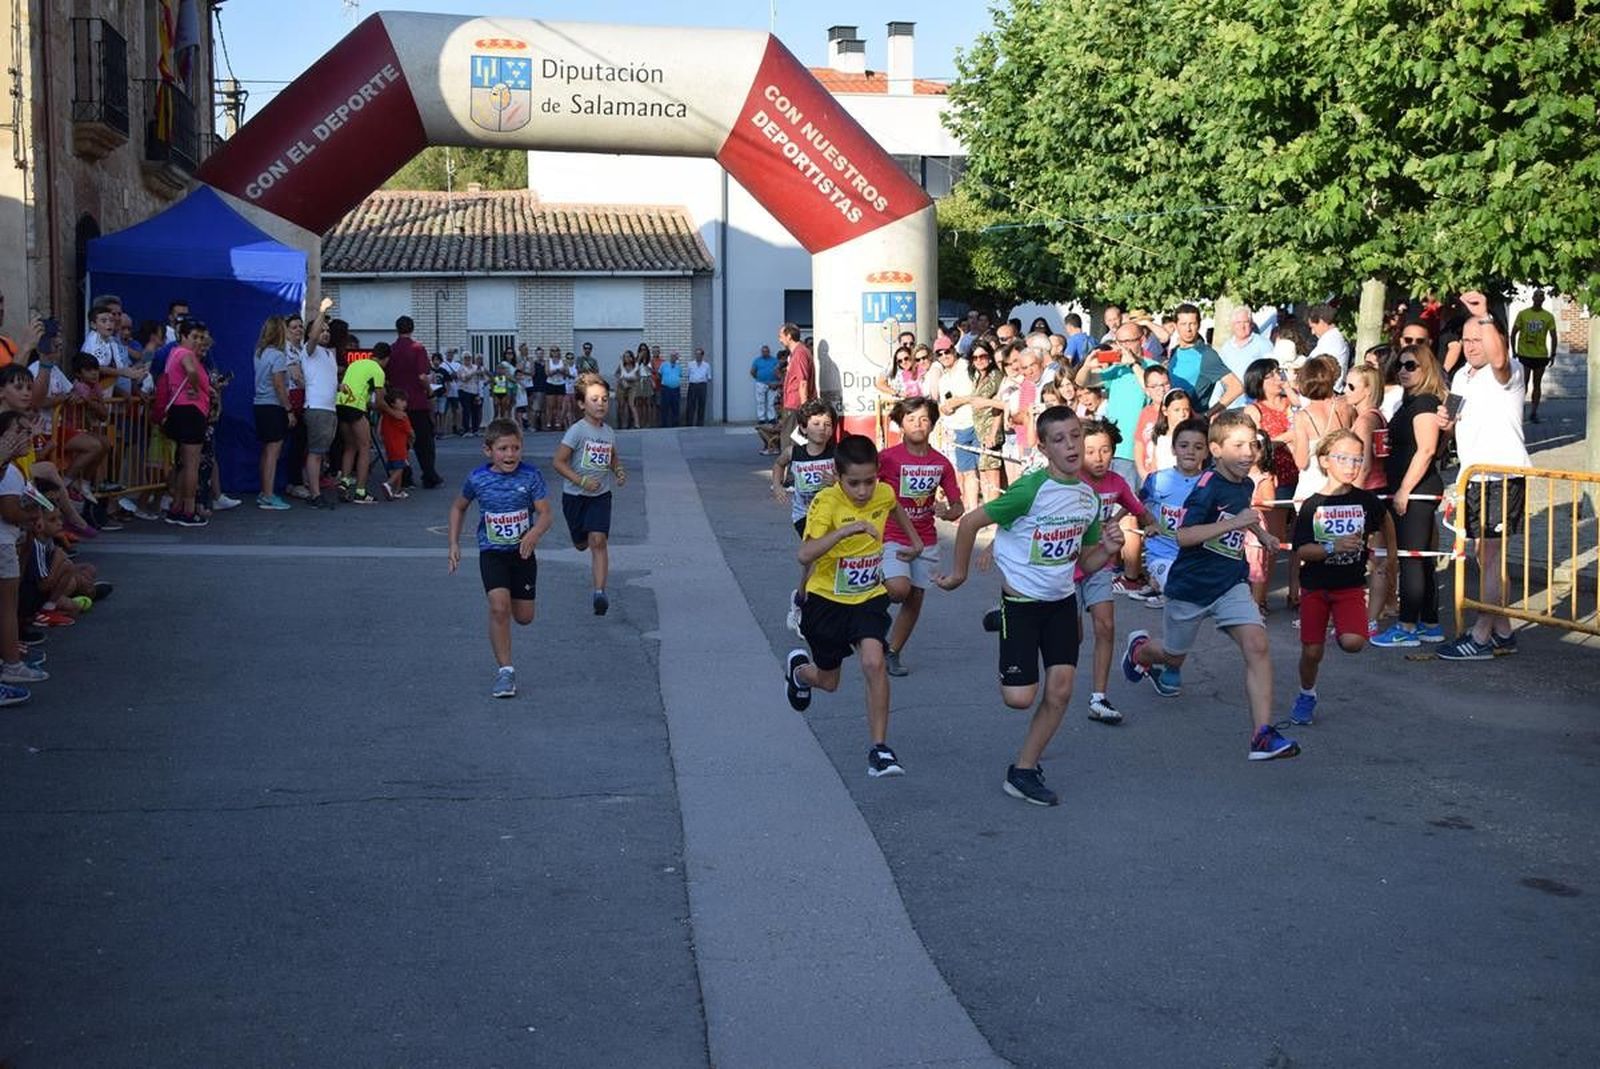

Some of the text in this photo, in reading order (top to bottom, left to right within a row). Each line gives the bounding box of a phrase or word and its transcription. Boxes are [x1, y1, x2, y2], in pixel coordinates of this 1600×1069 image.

[542, 58, 664, 85] Diputación
[541, 93, 687, 118] de Salamanca
[245, 63, 400, 199] CON EL DEPORTE
[764, 85, 888, 212] CON NUESTROS
[751, 109, 863, 223] DEPORTISTAS
[804, 471, 822, 484] 25
[909, 477, 934, 490] 262
[494, 523, 521, 537] 251
[1324, 519, 1355, 534] 256
[1041, 538, 1074, 558] 267
